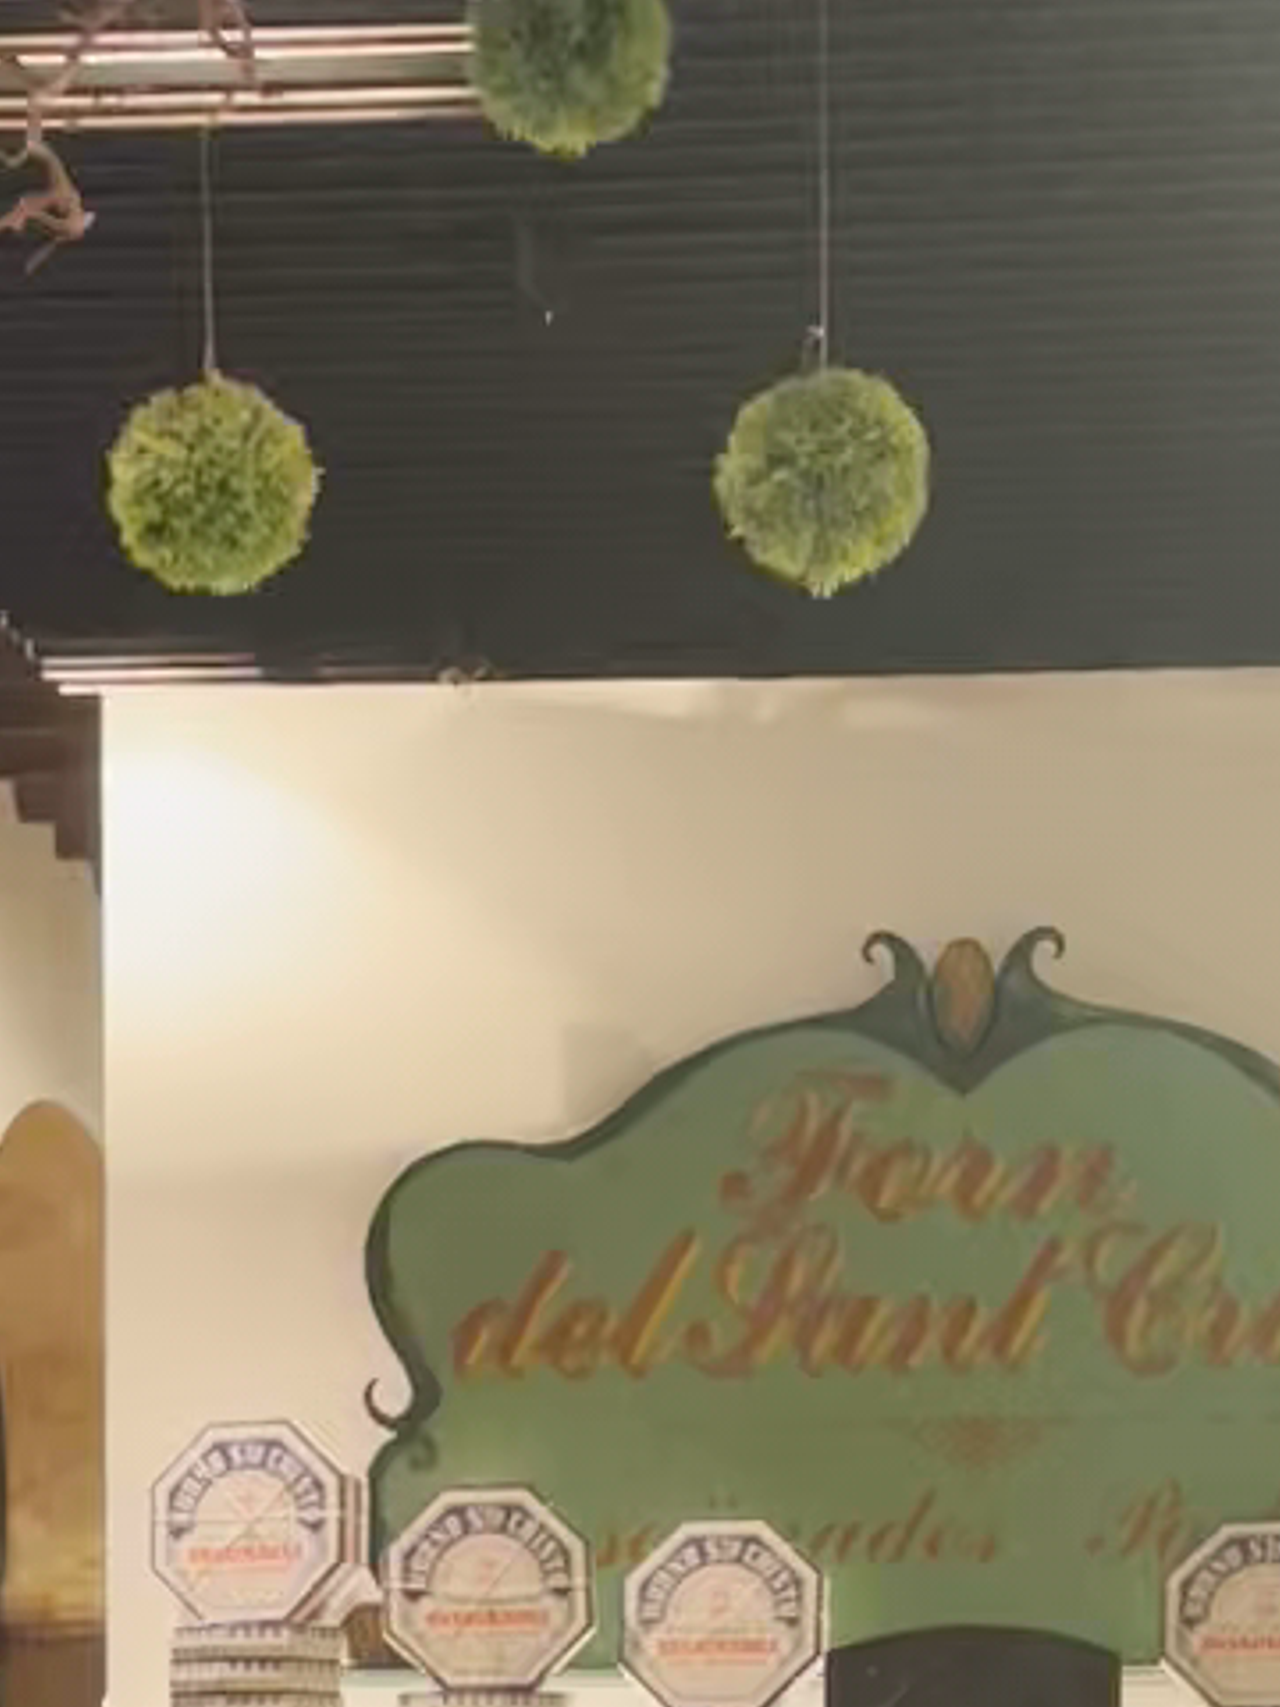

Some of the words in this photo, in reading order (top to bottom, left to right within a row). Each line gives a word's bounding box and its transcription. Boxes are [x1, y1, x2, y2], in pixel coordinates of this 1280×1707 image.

[716, 1065, 1142, 1238] Forn
[452, 1228, 705, 1379] del
[683, 1223, 1068, 1379] Sant
